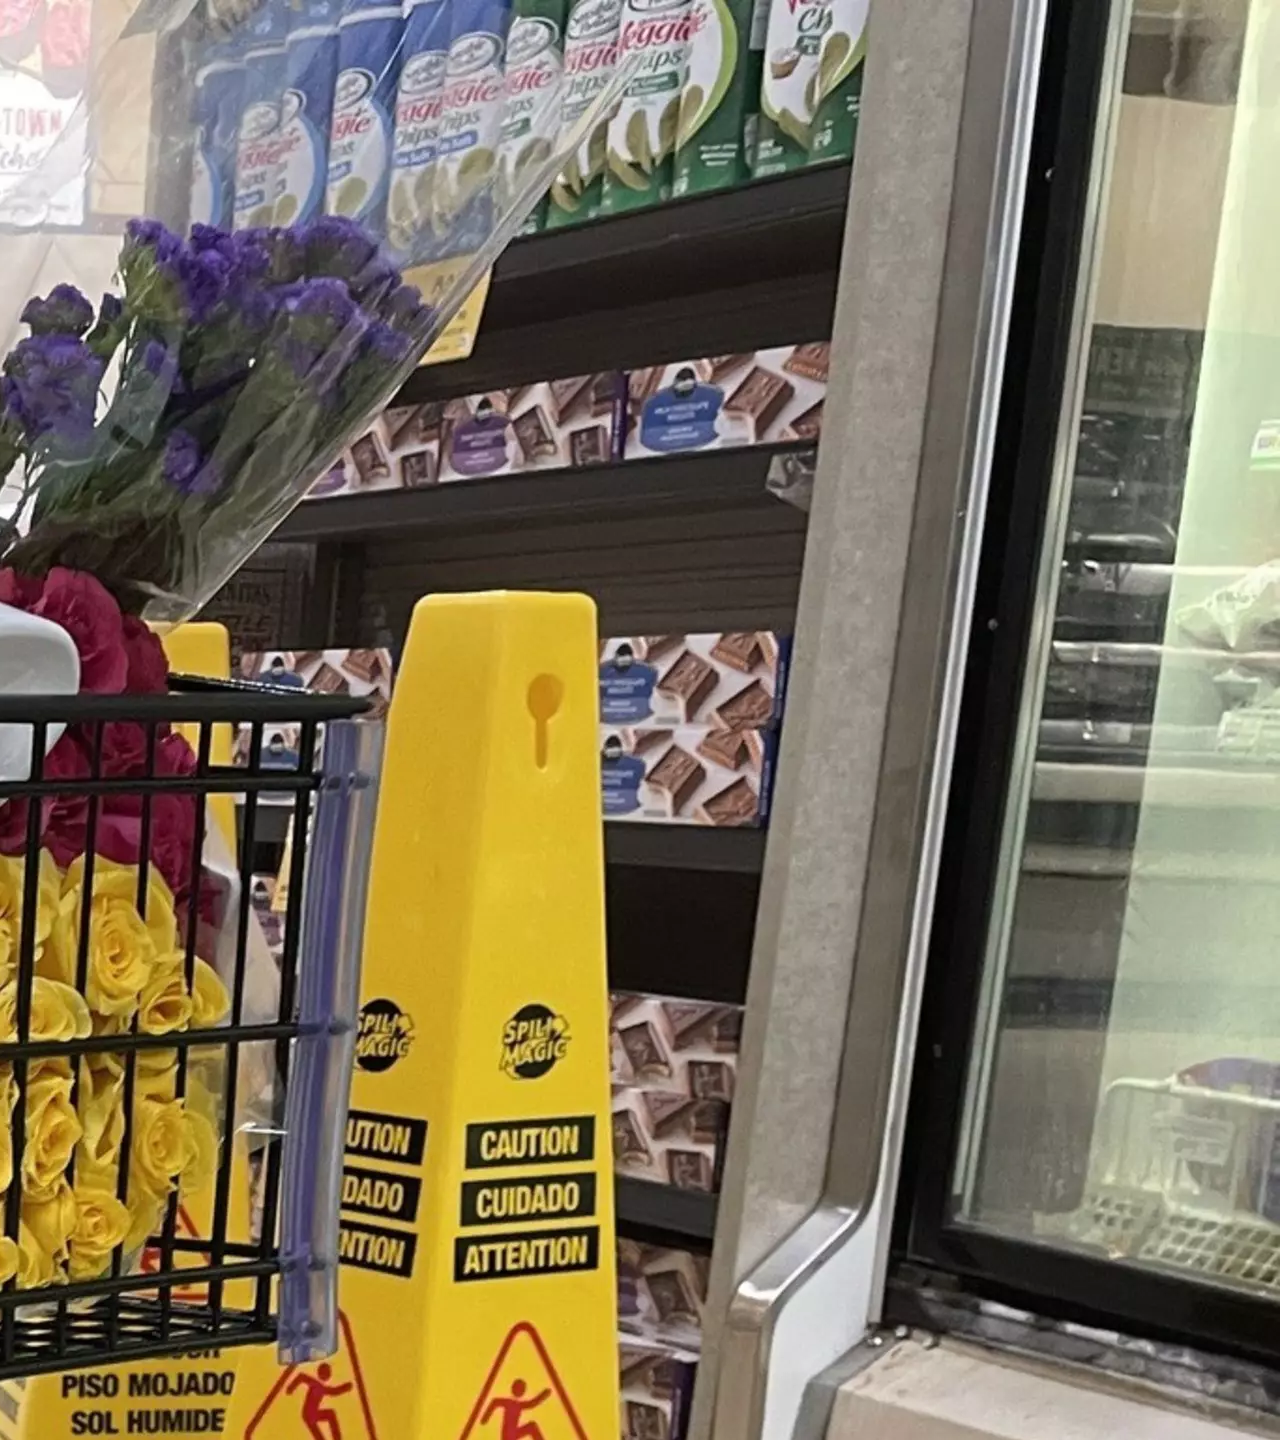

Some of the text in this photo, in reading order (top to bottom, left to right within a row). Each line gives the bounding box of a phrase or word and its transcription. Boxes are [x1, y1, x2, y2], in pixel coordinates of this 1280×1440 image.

[346, 1117, 412, 1155] UTION
[480, 1126, 580, 1160] CAUTION
[343, 1175, 404, 1212] DADO
[476, 1182, 580, 1218] CUIDADO
[340, 1231, 405, 1269] NTION
[464, 1235, 588, 1275] ATTENTION
[61, 1371, 236, 1399] PISO MOJADO
[71, 1408, 226, 1435] SOL HUMIDE
